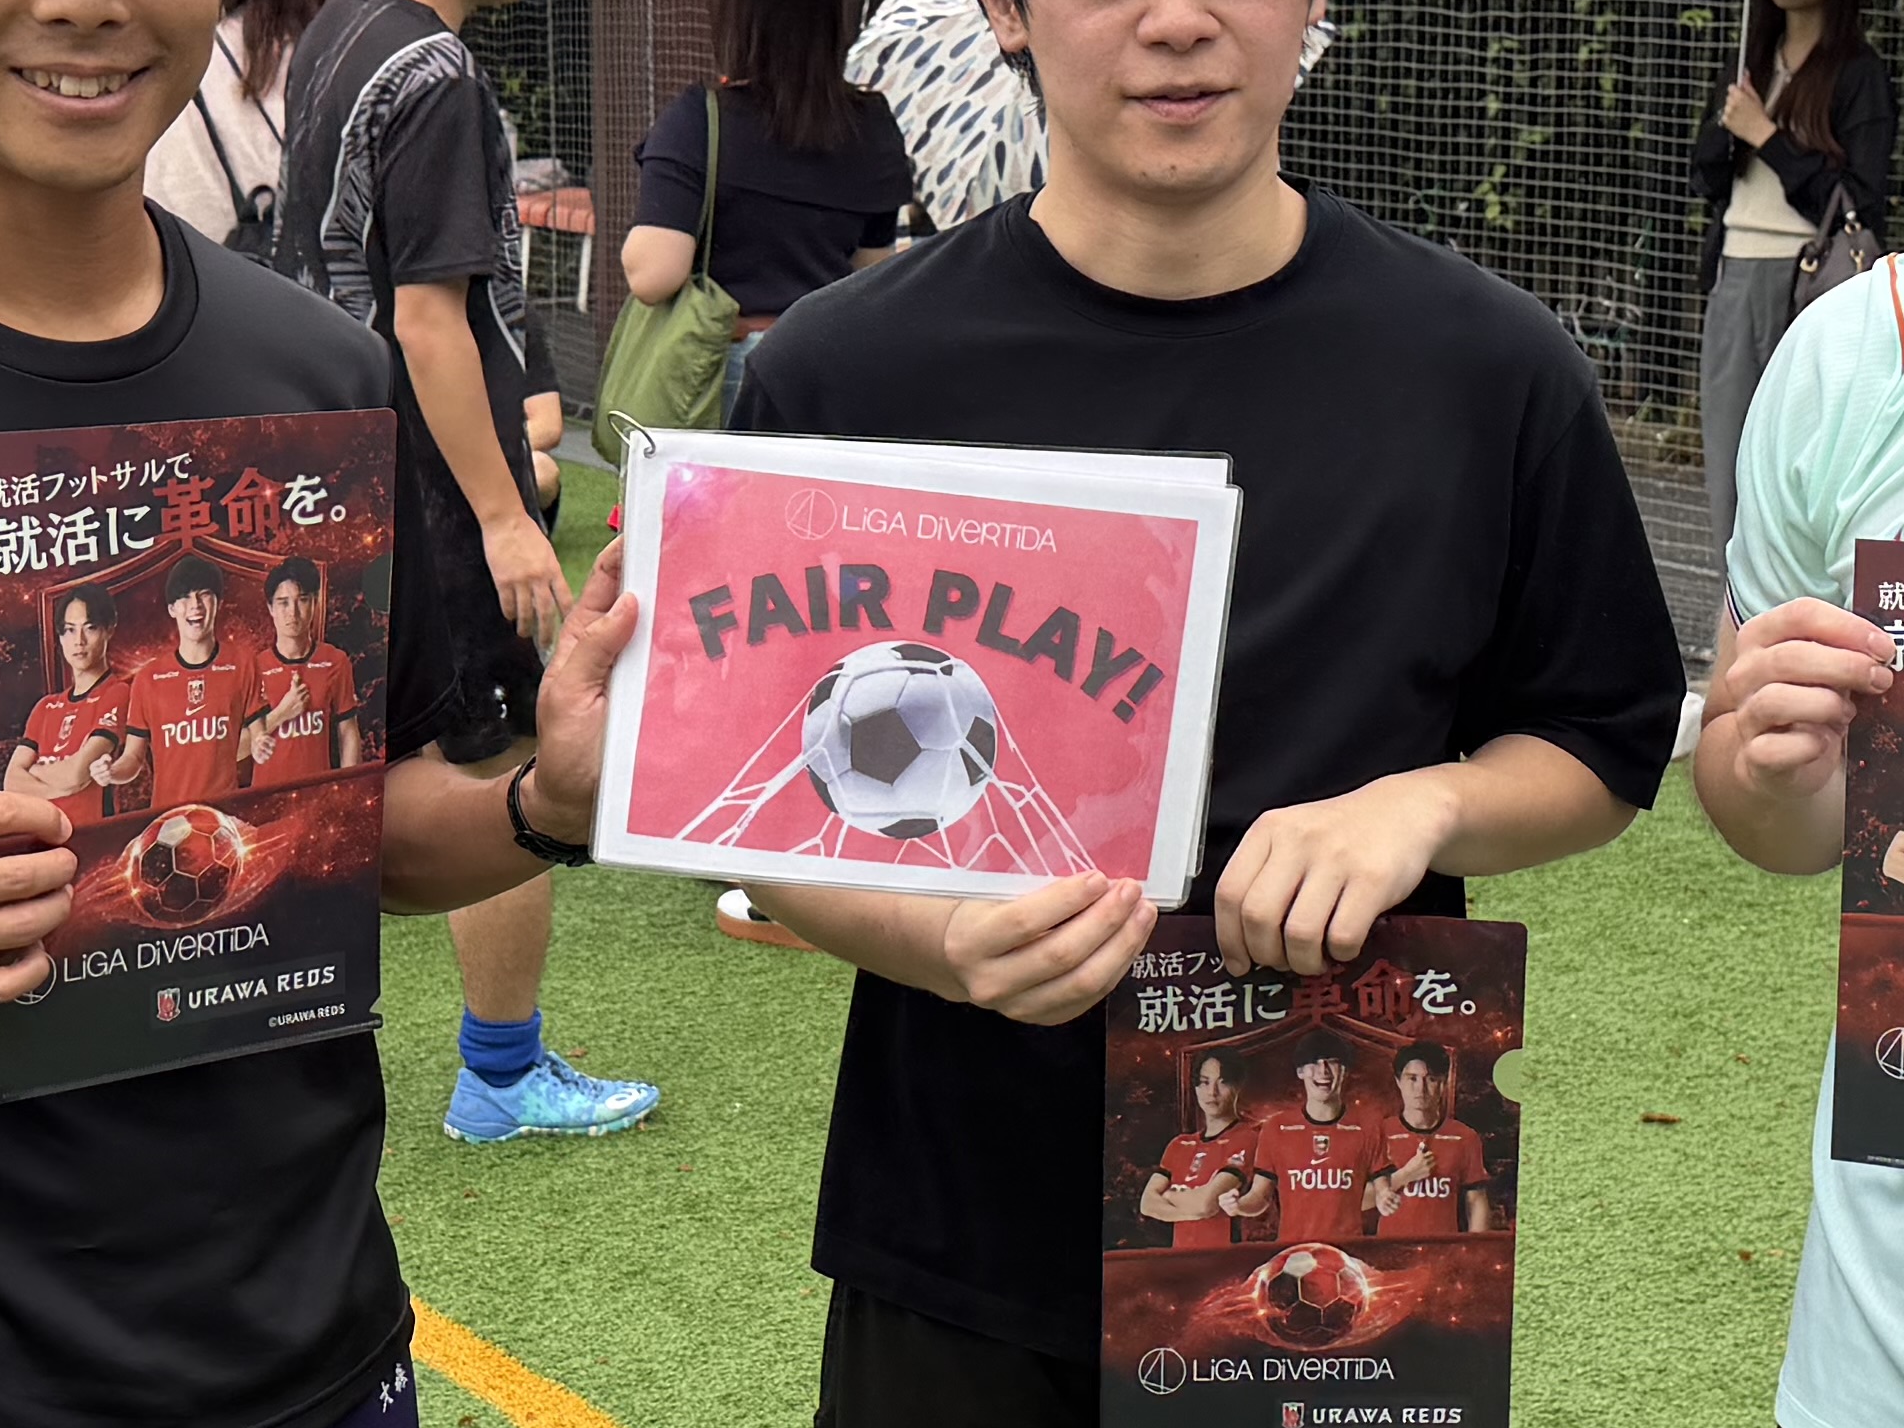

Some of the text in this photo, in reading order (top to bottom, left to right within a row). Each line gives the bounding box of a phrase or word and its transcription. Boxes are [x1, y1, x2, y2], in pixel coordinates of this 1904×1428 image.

[689, 563, 1164, 723] FAIR PLAY!
[162, 716, 229, 747] POLUS
[278, 710, 324, 736] OLUS
[1132, 952, 1225, 978] 就活フッ
[189, 966, 335, 1009] URAWA REDS
[318, 1004, 345, 1018] REDS
[1288, 1168, 1353, 1191] POLUS
[1404, 1177, 1450, 1198] OLUS
[1313, 1407, 1462, 1424] URAWA REDS
